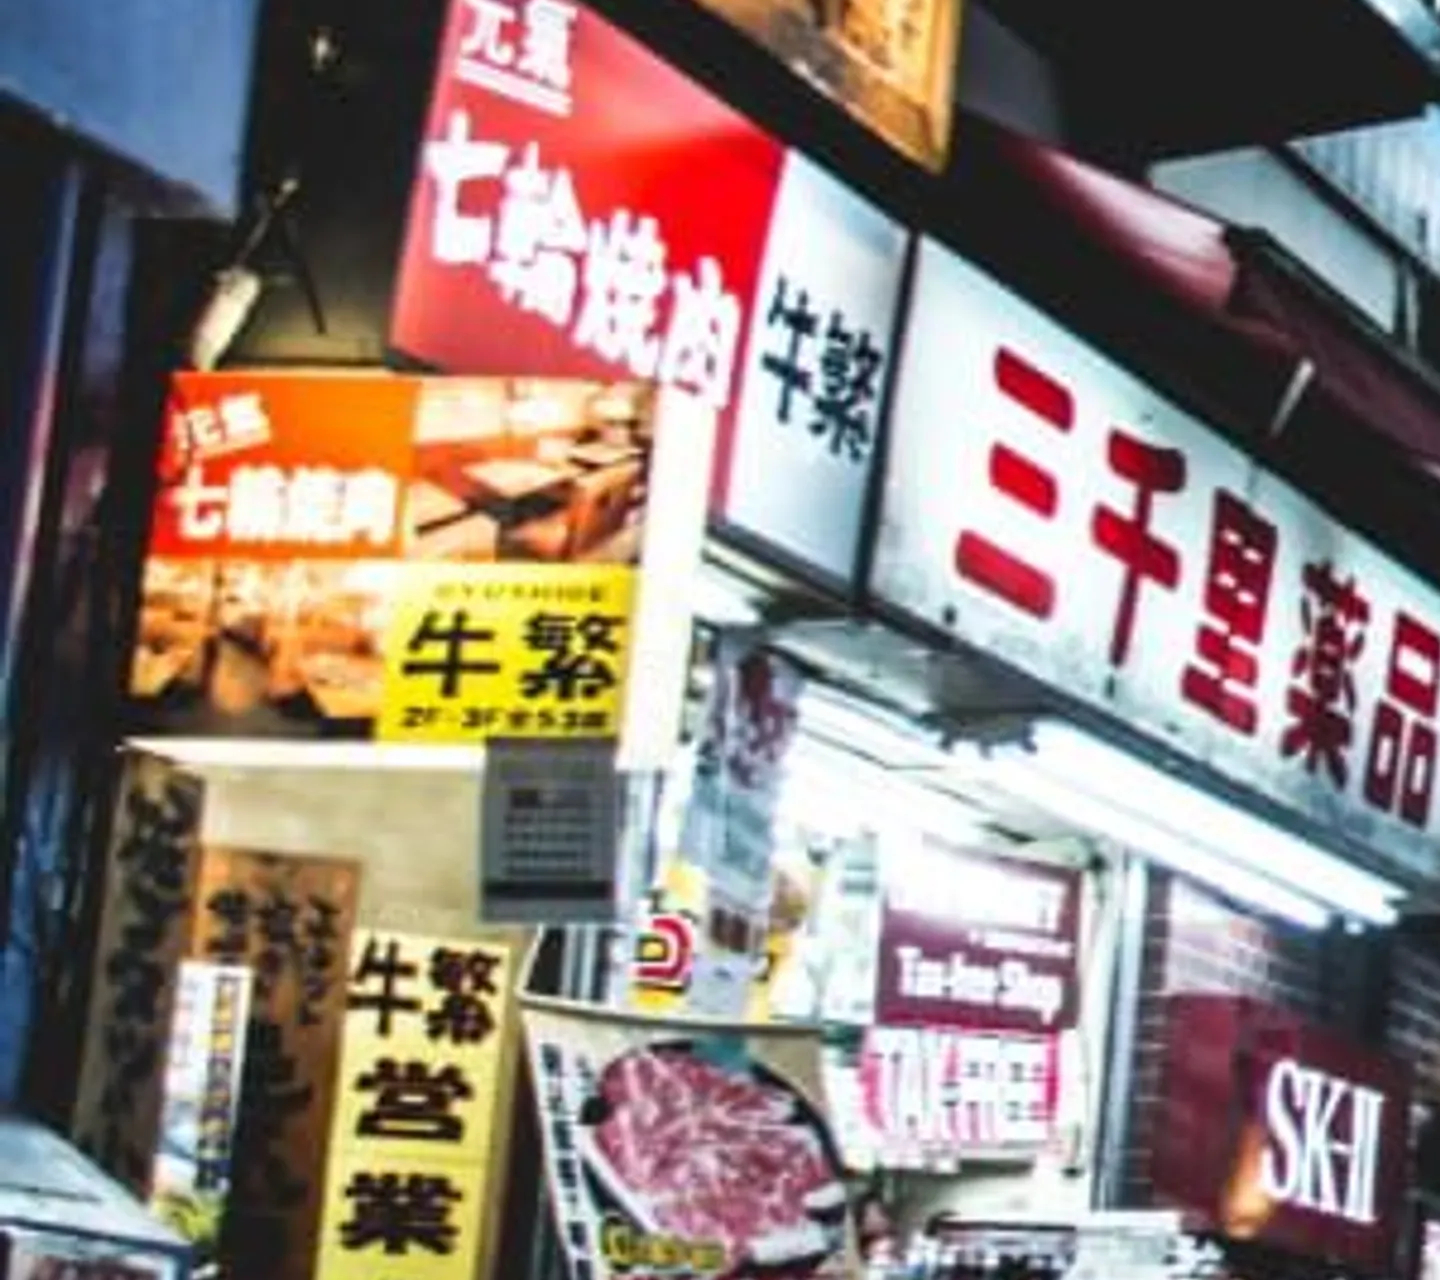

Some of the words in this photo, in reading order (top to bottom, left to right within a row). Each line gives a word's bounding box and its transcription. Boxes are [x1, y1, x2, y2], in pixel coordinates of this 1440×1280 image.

[762, 275, 885, 465] 牛繁
[401, 608, 629, 702] 牛繁
[348, 939, 500, 1045] 牛繁
[1258, 1057, 1387, 1224] SK-II
